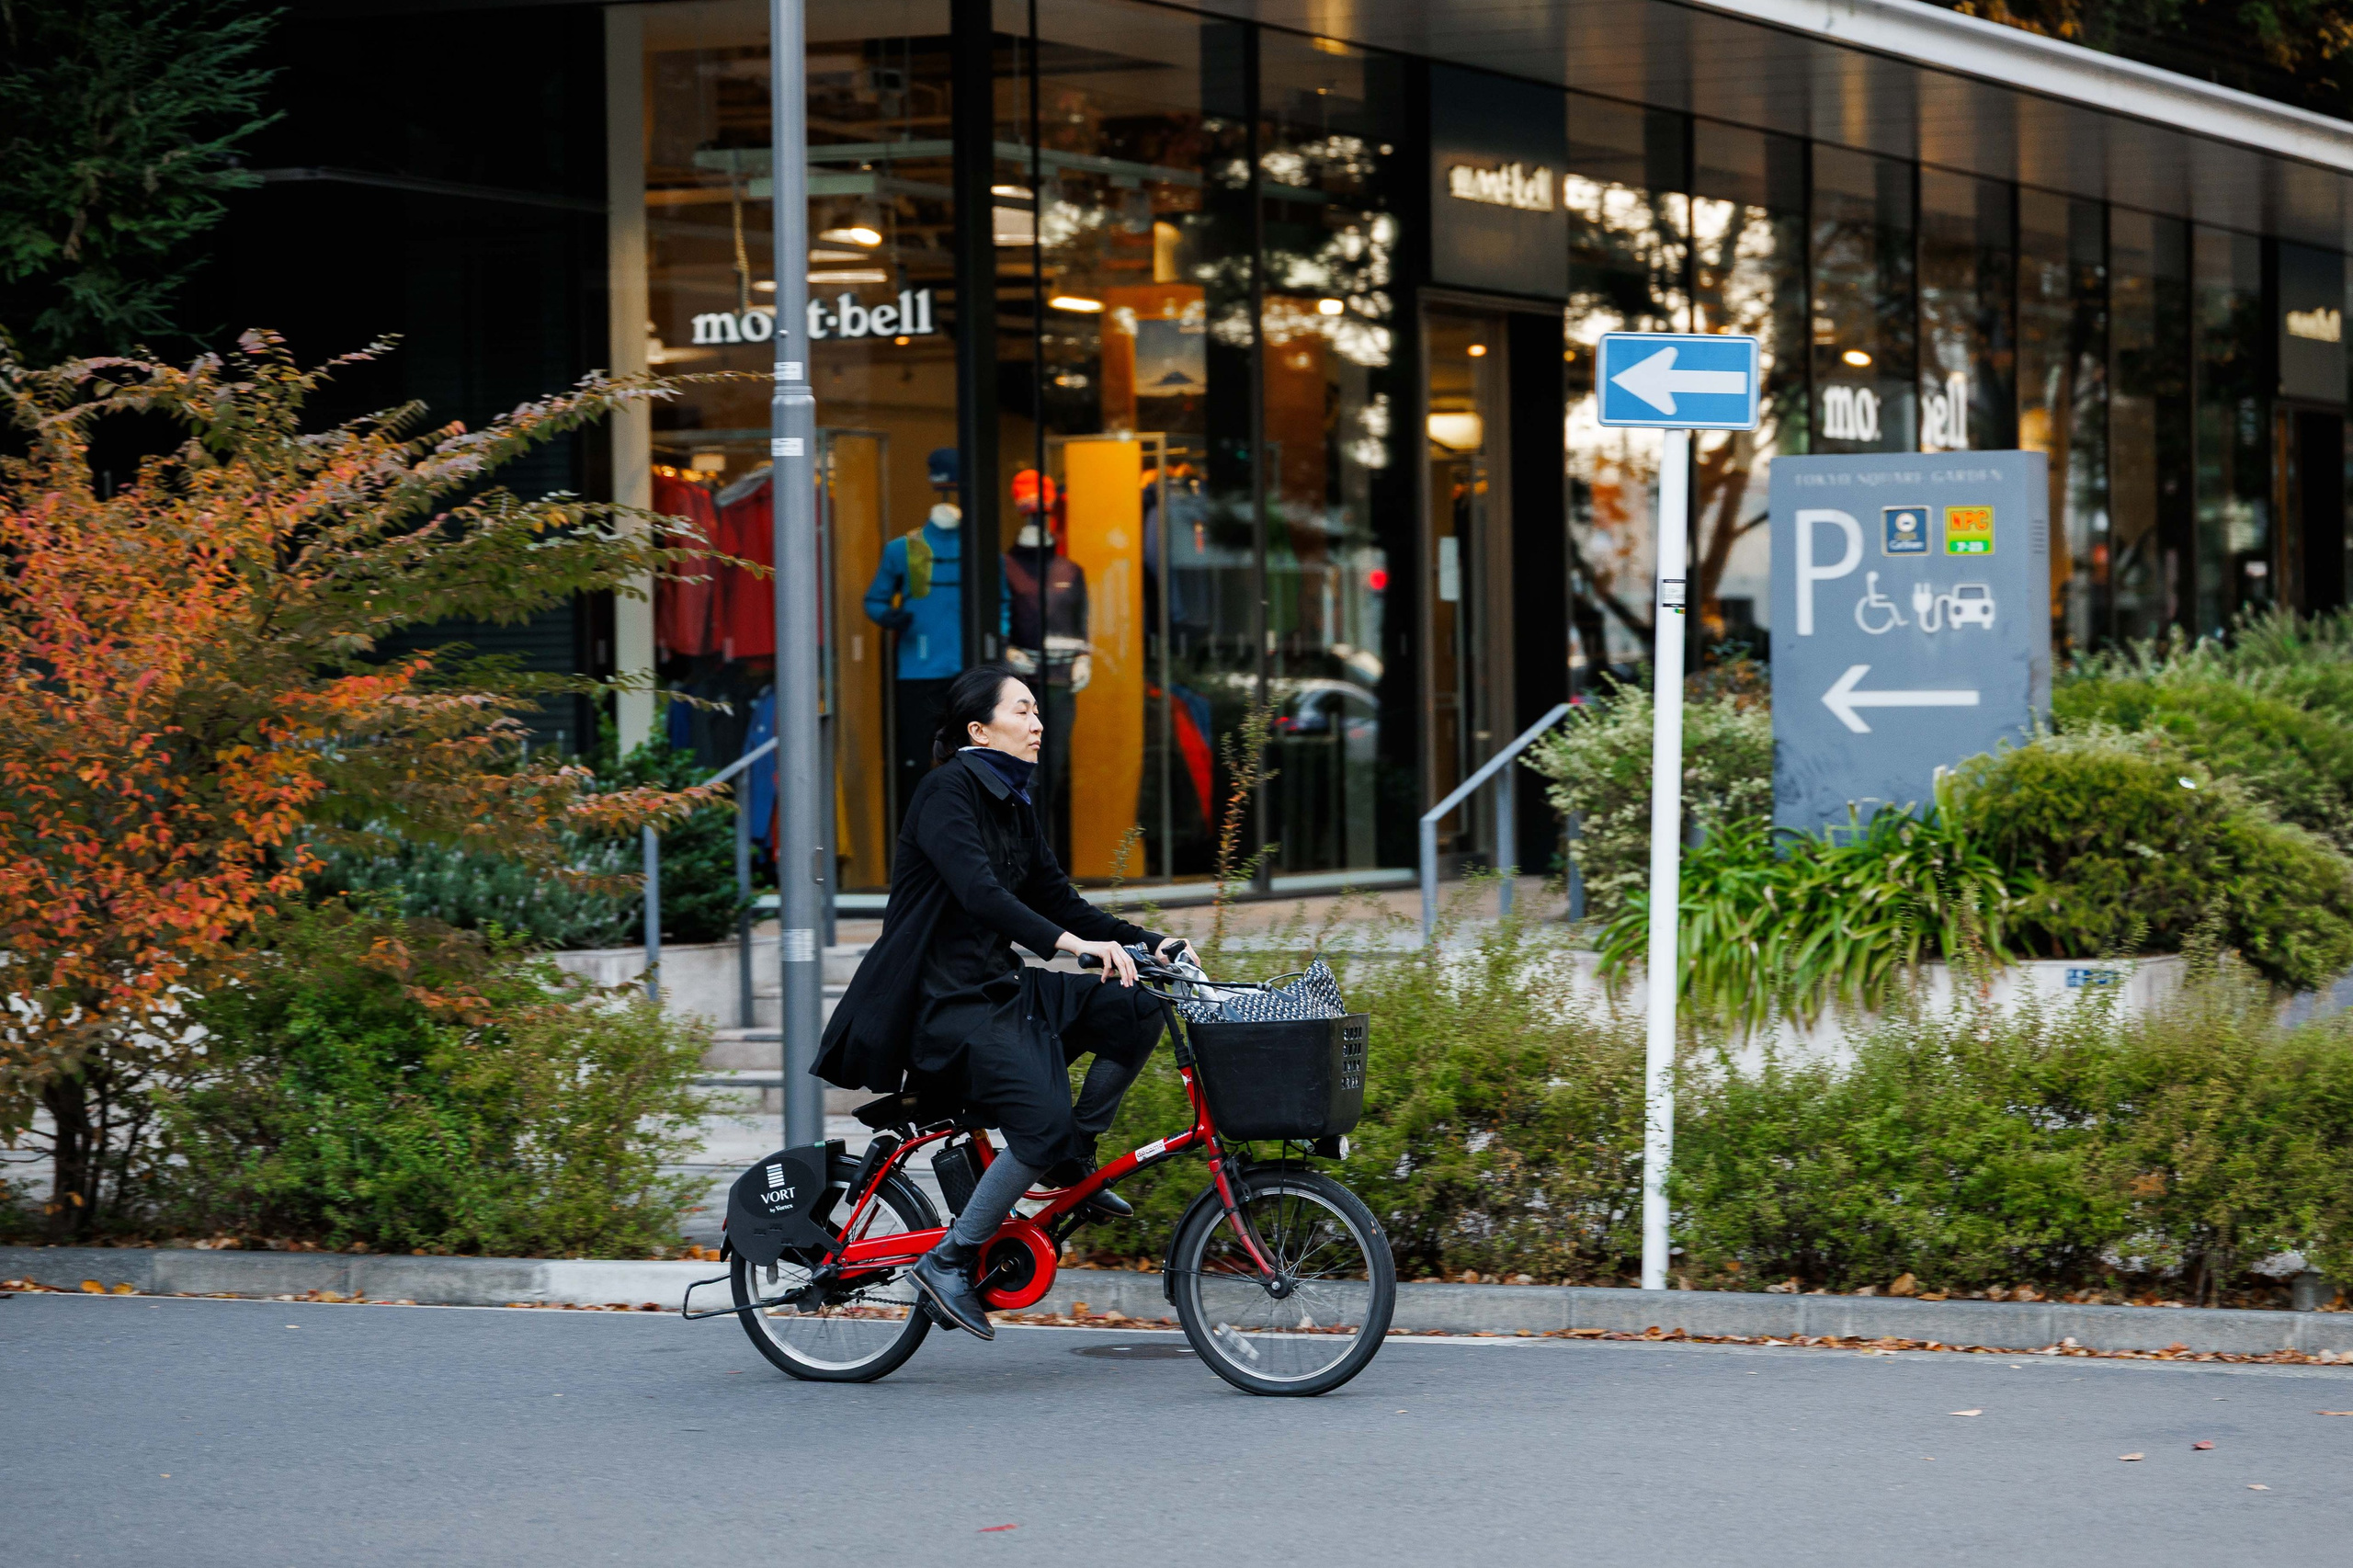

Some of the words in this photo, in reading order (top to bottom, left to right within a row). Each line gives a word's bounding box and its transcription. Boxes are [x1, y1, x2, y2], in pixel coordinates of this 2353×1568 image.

[691, 289, 935, 345] mot·bell
[1950, 510, 1988, 530] NPC
[1795, 509, 1864, 636] P
[760, 1187, 795, 1204] VORT
